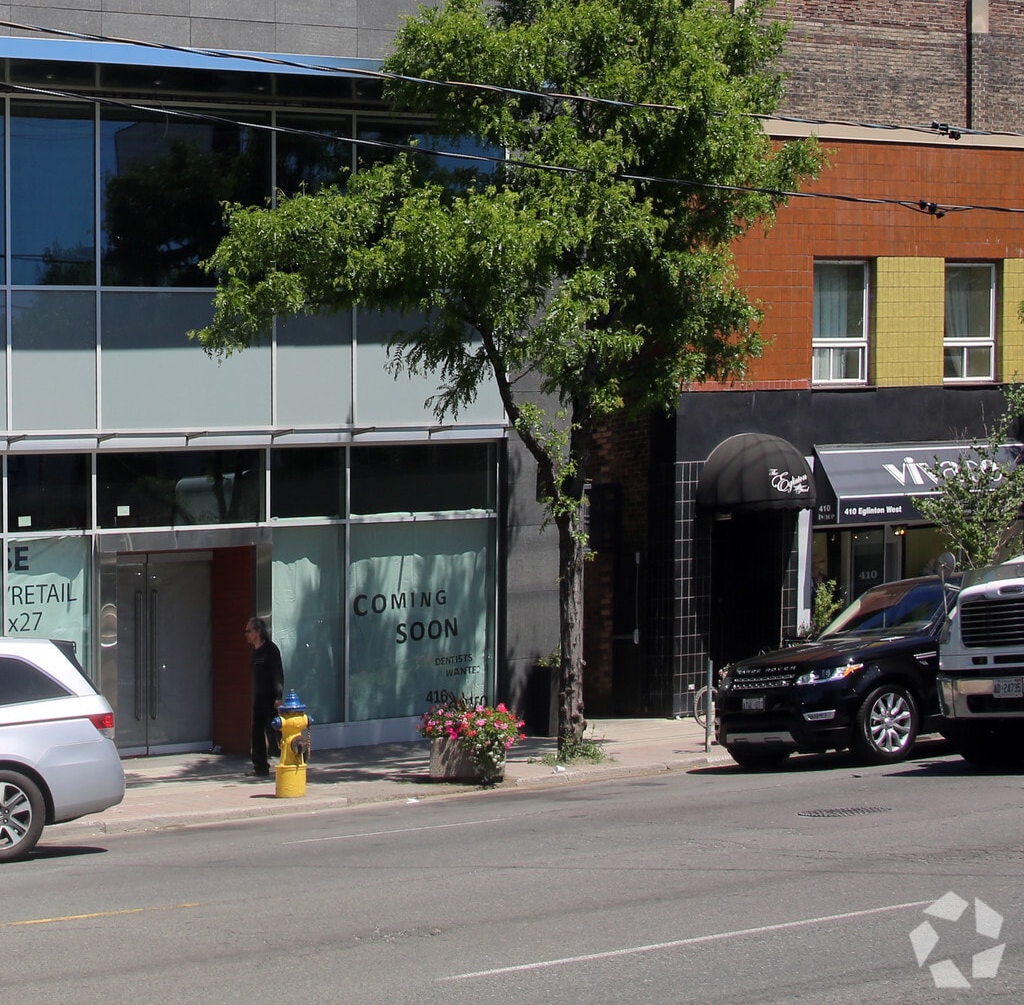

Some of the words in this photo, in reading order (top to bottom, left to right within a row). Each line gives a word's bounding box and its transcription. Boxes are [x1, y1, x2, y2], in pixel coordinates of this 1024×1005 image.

[844, 507, 857, 515] 410
[858, 506, 885, 517] Eglinton
[886, 505, 902, 514] West
[353, 589, 447, 617] COMING
[8, 611, 43, 633] x27
[395, 617, 458, 644] SOON
[435, 653, 473, 667] DENTISTS
